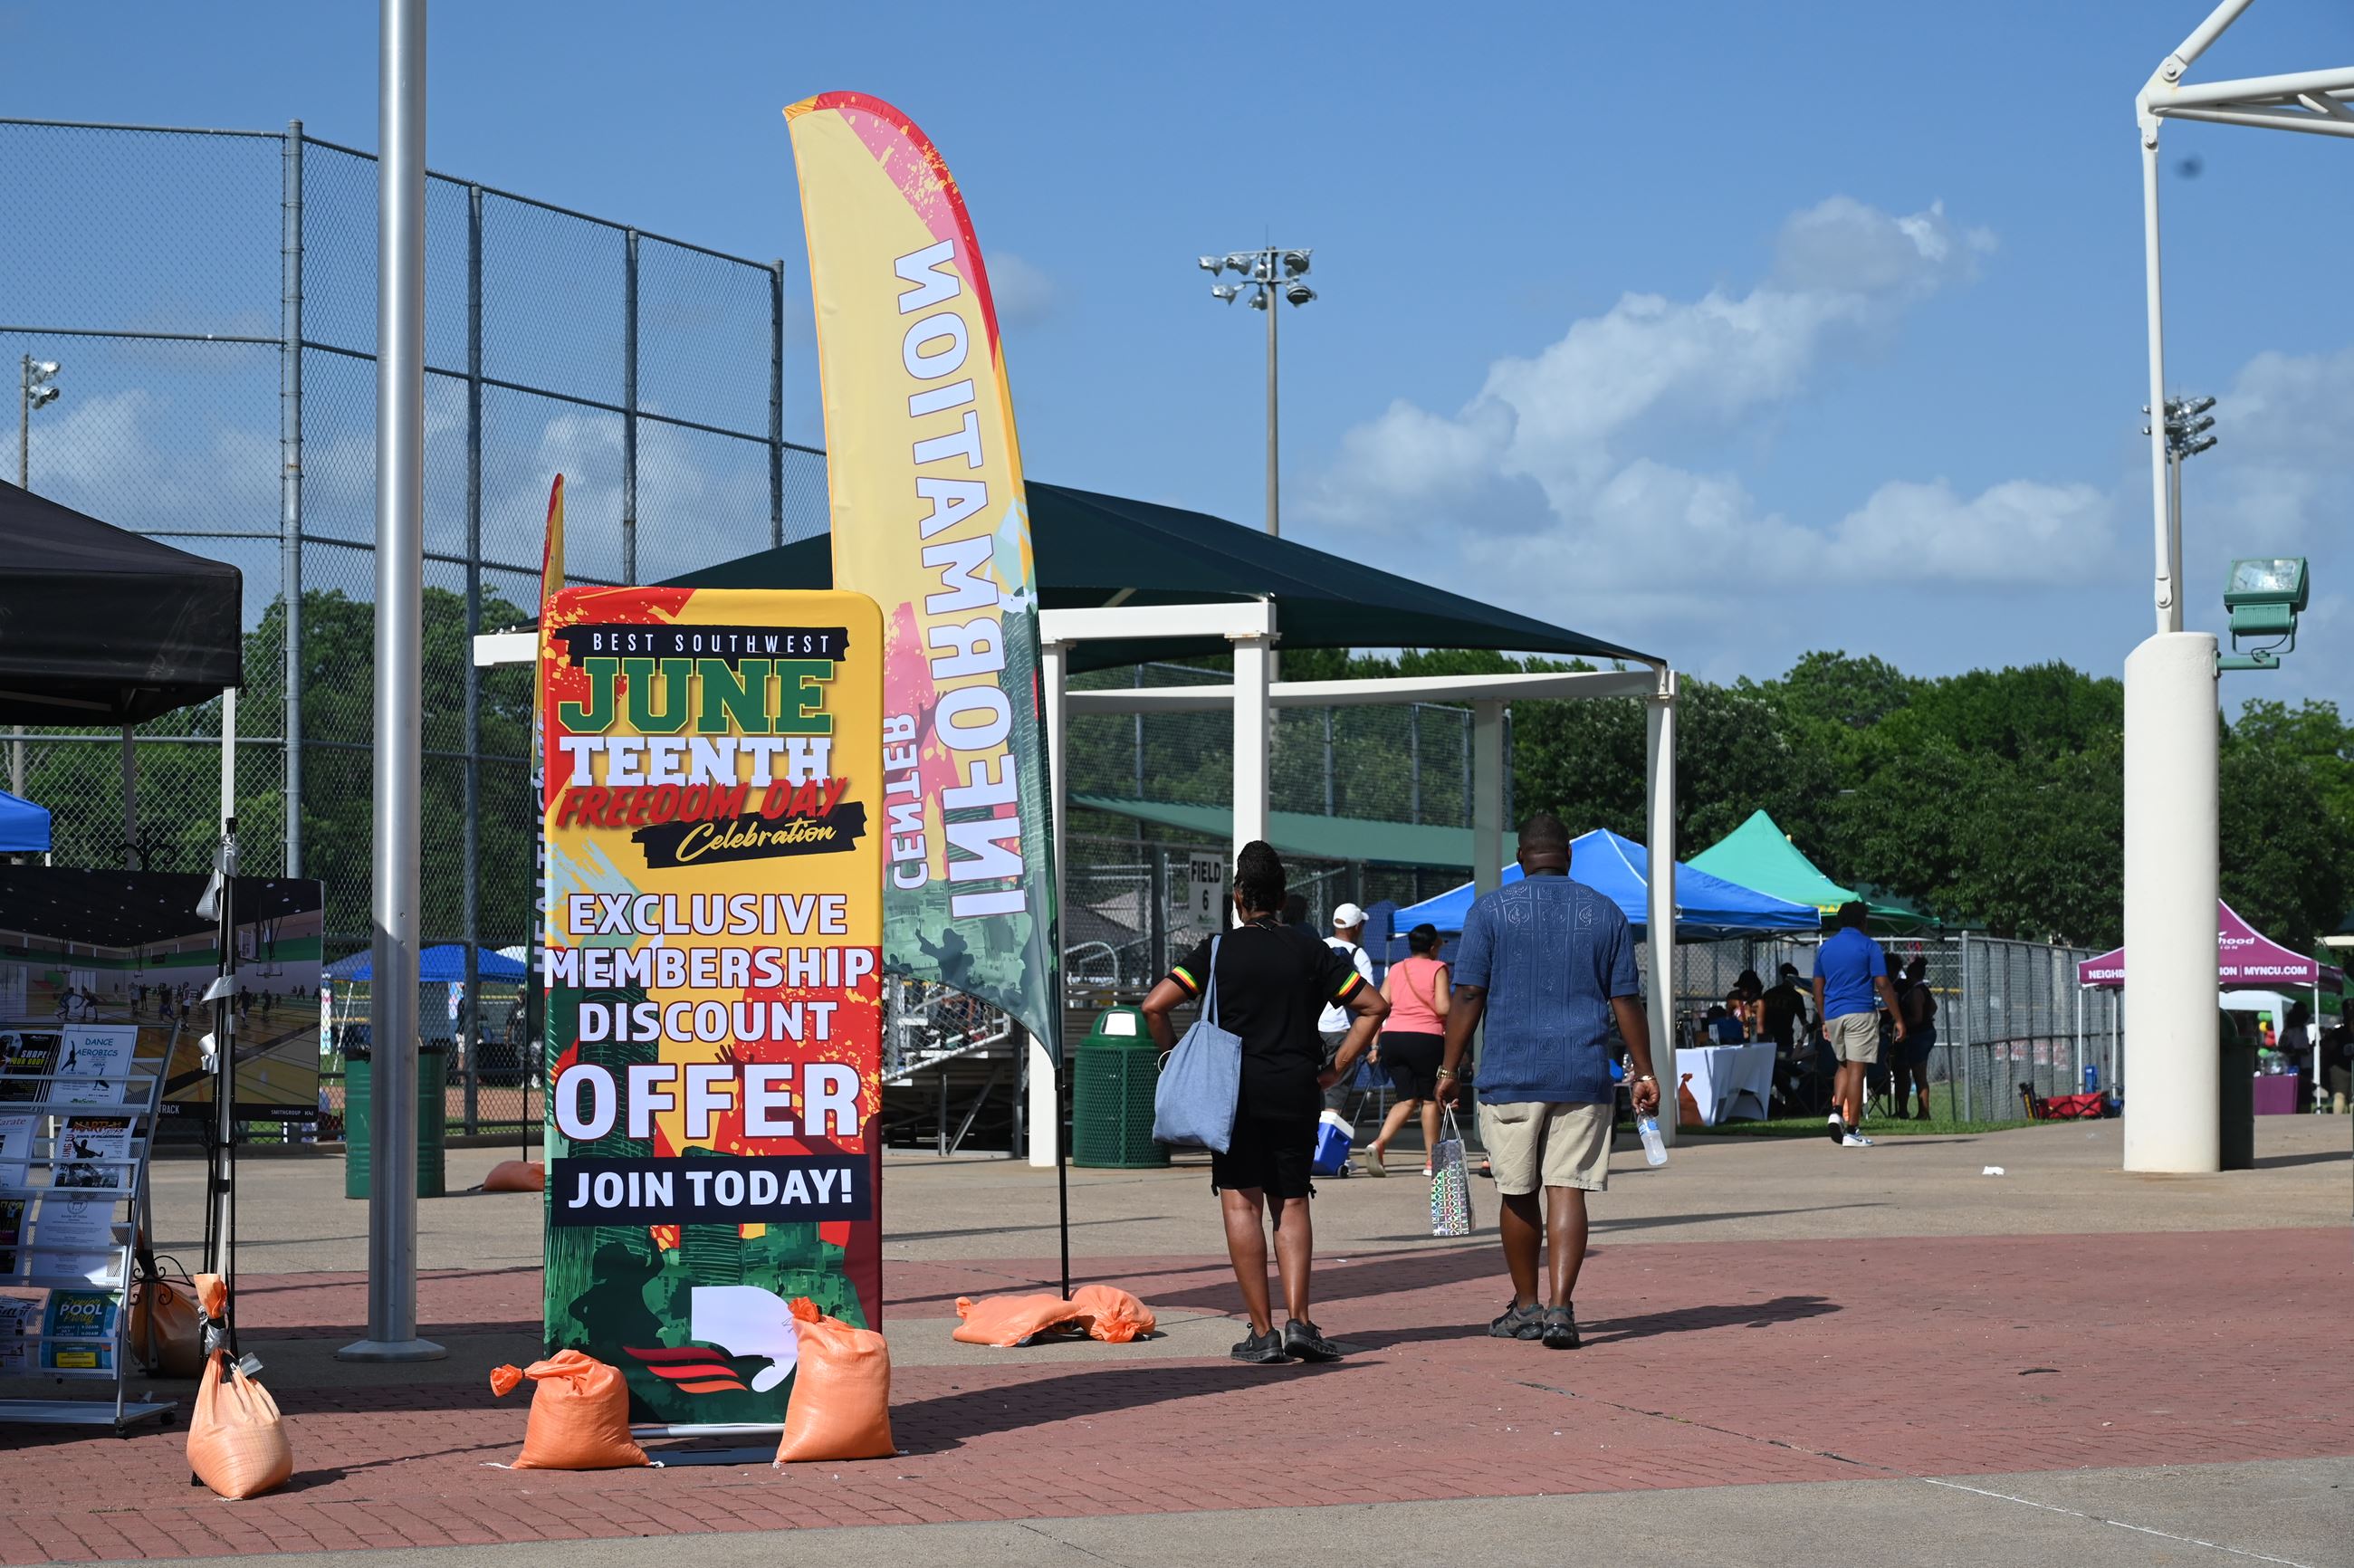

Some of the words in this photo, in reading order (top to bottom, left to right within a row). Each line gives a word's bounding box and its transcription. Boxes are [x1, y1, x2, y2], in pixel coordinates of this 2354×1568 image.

[593, 634, 654, 652] BEST
[675, 634, 831, 654] SOUTHWEST
[558, 656, 834, 735] JUNE
[559, 736, 831, 789] TEENTH
[555, 779, 750, 829] FREEDOM
[760, 776, 848, 820] DAY
[675, 817, 837, 863] Celebration
[1191, 860, 1221, 884] FIELD
[568, 894, 847, 935] EXCLUSIVE
[1202, 889, 1210, 911] 6
[2218, 936, 2255, 944] hood
[544, 946, 876, 990] MEMBERSHIP
[2088, 969, 2125, 980] NEIGHB
[2219, 966, 2237, 976] ION
[2244, 965, 2308, 976] MYNCU.COM
[85, 1037, 114, 1046] DANCE
[578, 1000, 838, 1043] DISCOUNT
[0, 1118, 26, 1126] arate
[554, 1063, 861, 1141] OFFER
[568, 1171, 675, 1209] JOIN
[685, 1168, 852, 1207] TODAY!
[60, 1304, 102, 1315] POOL
